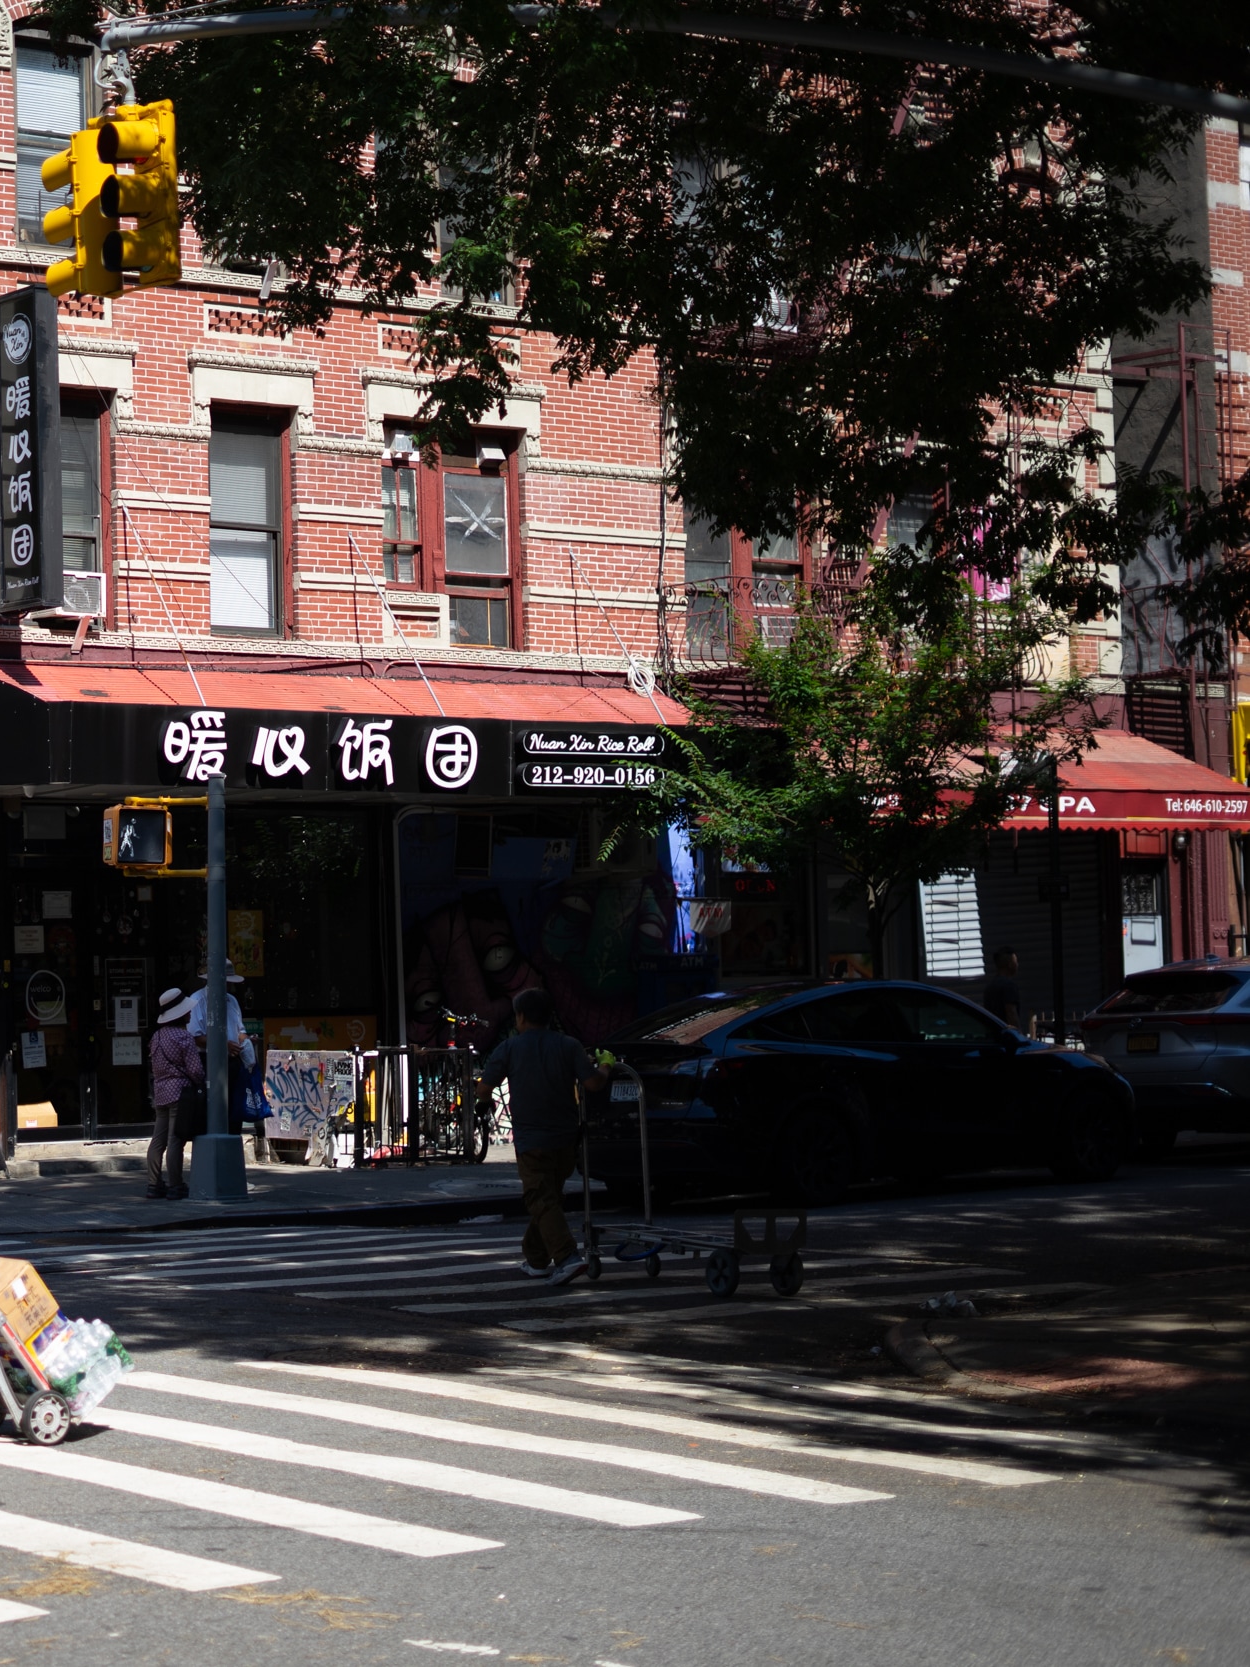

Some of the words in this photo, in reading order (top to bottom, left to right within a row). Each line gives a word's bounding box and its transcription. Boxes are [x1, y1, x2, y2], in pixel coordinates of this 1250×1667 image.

[3, 324, 22, 339] Nuan
[11, 337, 24, 353] Xin
[5, 376, 34, 566] 暖心饭团
[163, 710, 478, 789] 暖心饭团
[530, 733, 567, 751] Nuan
[569, 734, 595, 751] Xin
[597, 735, 625, 752] Rice
[532, 766, 656, 785] 212-920-0156
[1165, 798, 1183, 812] Tel:
[1184, 799, 1248, 813] 646-610-2597
[735, 878, 777, 893] ON
[699, 907, 723, 919] ATM
[680, 956, 704, 968] ATM
